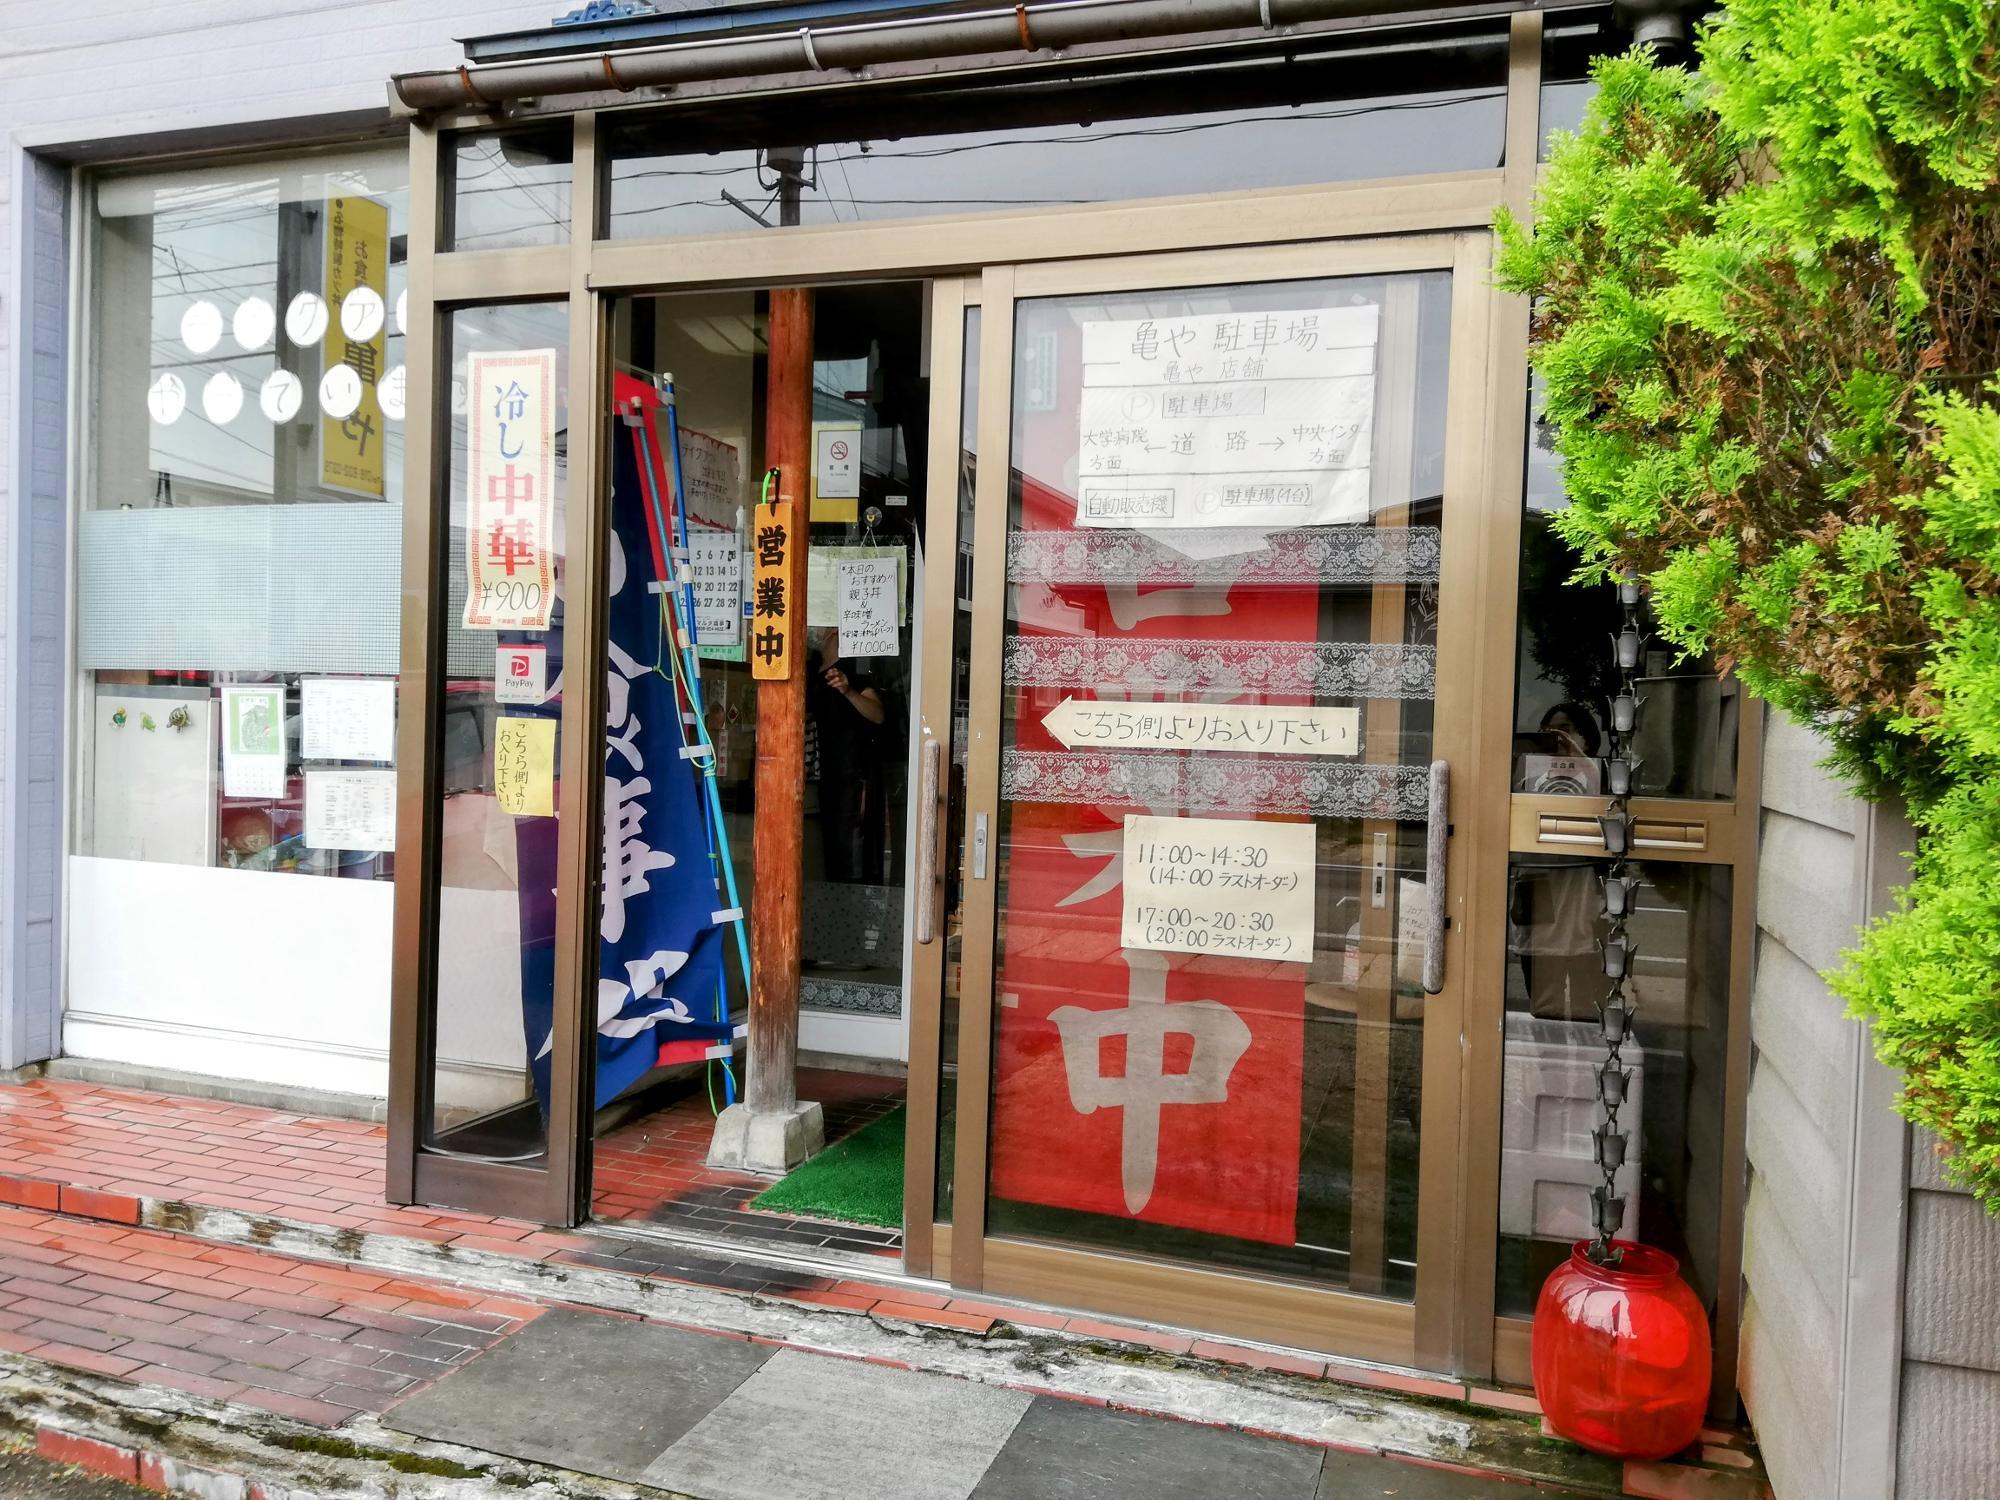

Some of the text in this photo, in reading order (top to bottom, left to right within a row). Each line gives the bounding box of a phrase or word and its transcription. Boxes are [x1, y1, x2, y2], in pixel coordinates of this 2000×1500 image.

[1131, 314, 1320, 361] 亀や 駐車場
[1163, 356, 1269, 384] 亀や 店舗
[1168, 392, 1233, 416] 駐車場
[1083, 426, 1149, 447] 大学病院
[1089, 454, 1122, 470] 方面
[1309, 448, 1345, 465] 方面
[487, 380, 535, 577] 冷し中華
[1089, 491, 1168, 515] 自動販売機
[696, 549, 703, 560] 5
[707, 549, 714, 560] 6
[718, 549, 725, 560] 7
[693, 565, 703, 576] 12
[705, 565, 715, 576] 13
[717, 565, 726, 576] 14
[729, 565, 738, 576] 15
[481, 579, 542, 612] ¥900
[692, 582, 702, 592] 19
[704, 582, 714, 592] 20
[717, 582, 726, 592] 21
[728, 582, 738, 592] 22
[755, 524, 787, 666] 営業中
[703, 598, 713, 608] 27
[715, 598, 725, 608] 28
[727, 598, 737, 608] 29
[505, 678, 535, 689] PayPay
[1072, 710, 1347, 745] こちら側よりお入り下さい
[514, 723, 529, 812] こちら側より
[1138, 843, 1269, 868] 11:00~14:30
[1136, 906, 1274, 932] 17:00~20:30
